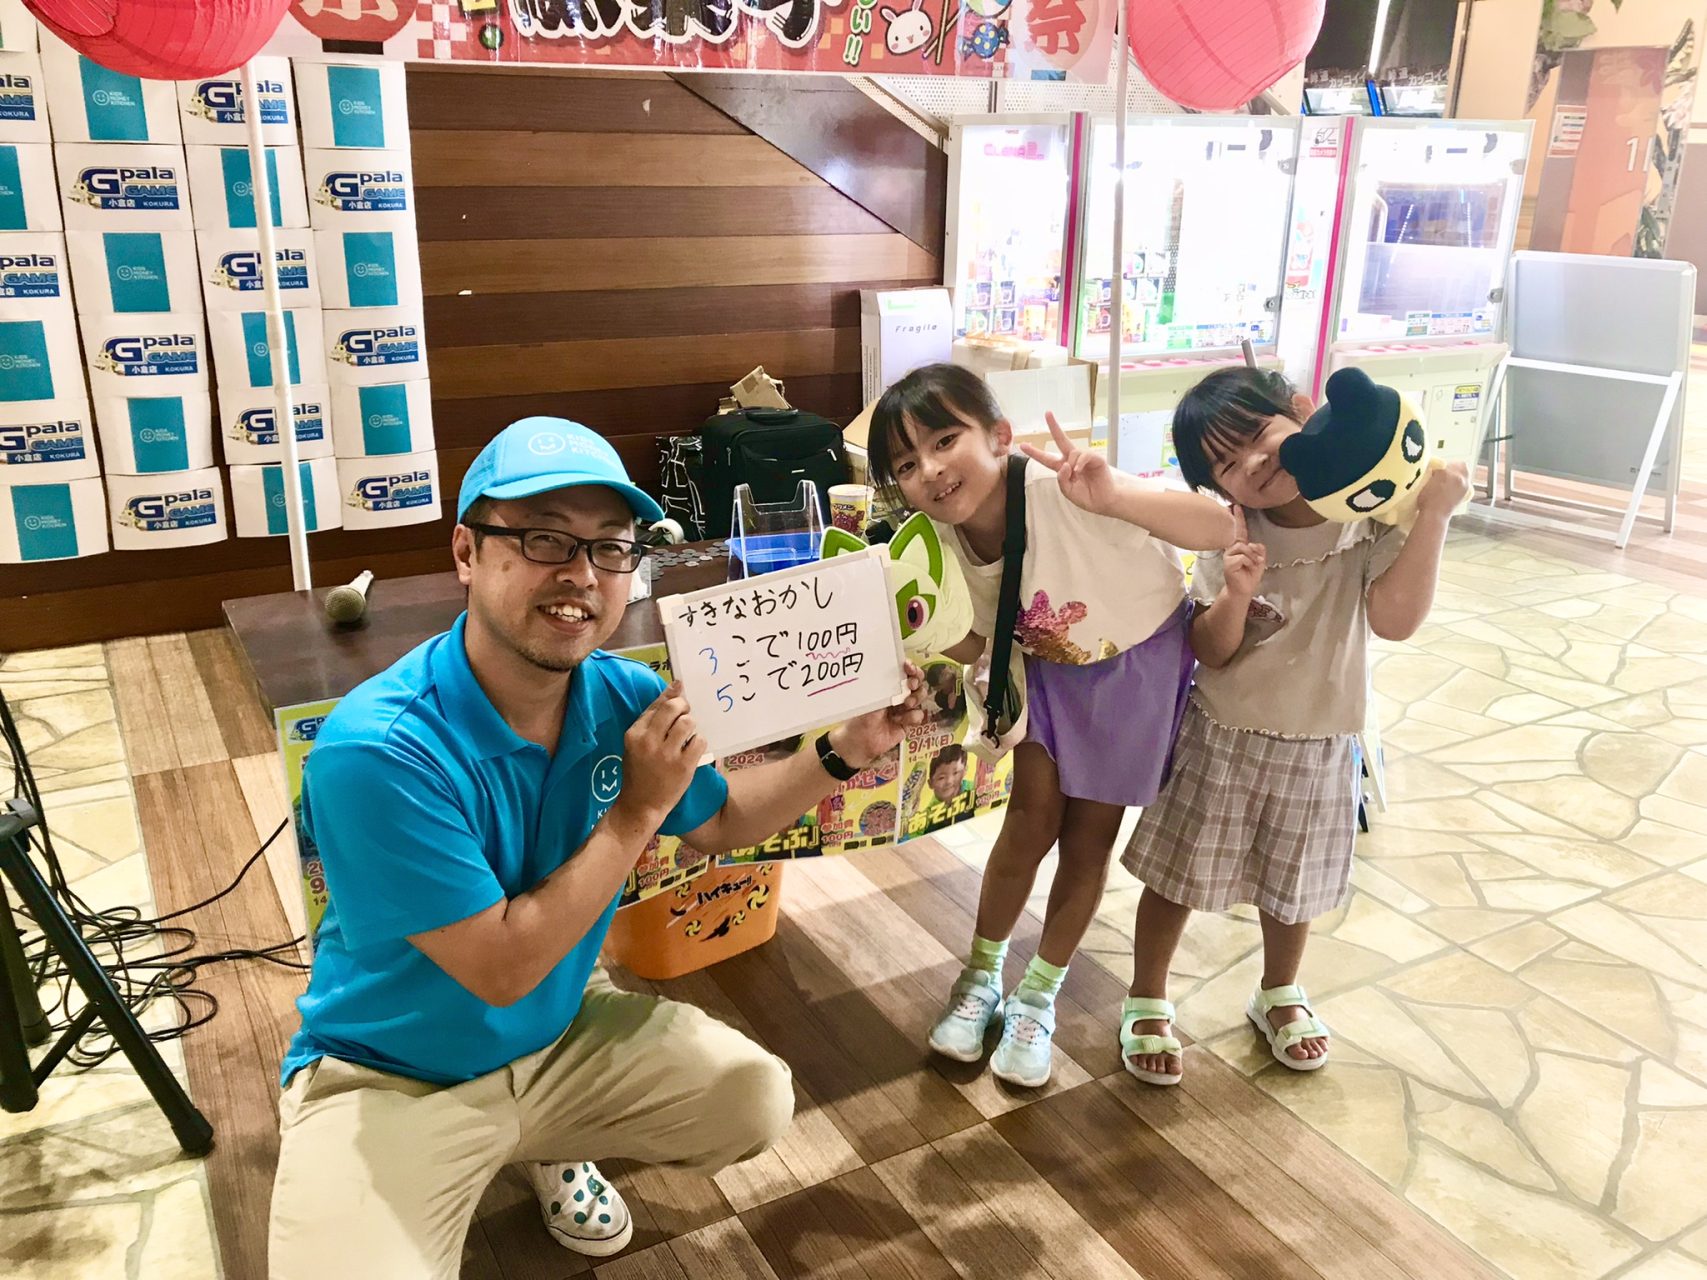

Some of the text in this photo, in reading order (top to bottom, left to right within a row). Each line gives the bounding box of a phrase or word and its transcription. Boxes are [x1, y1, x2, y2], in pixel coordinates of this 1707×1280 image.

[843, 0, 877, 66] い!!
[0, 254, 55, 270] pala
[895, 323, 938, 334] Fragile
[678, 576, 833, 627] すきなおかし
[910, 724, 937, 738] 2024
[728, 753, 765, 766] 2024
